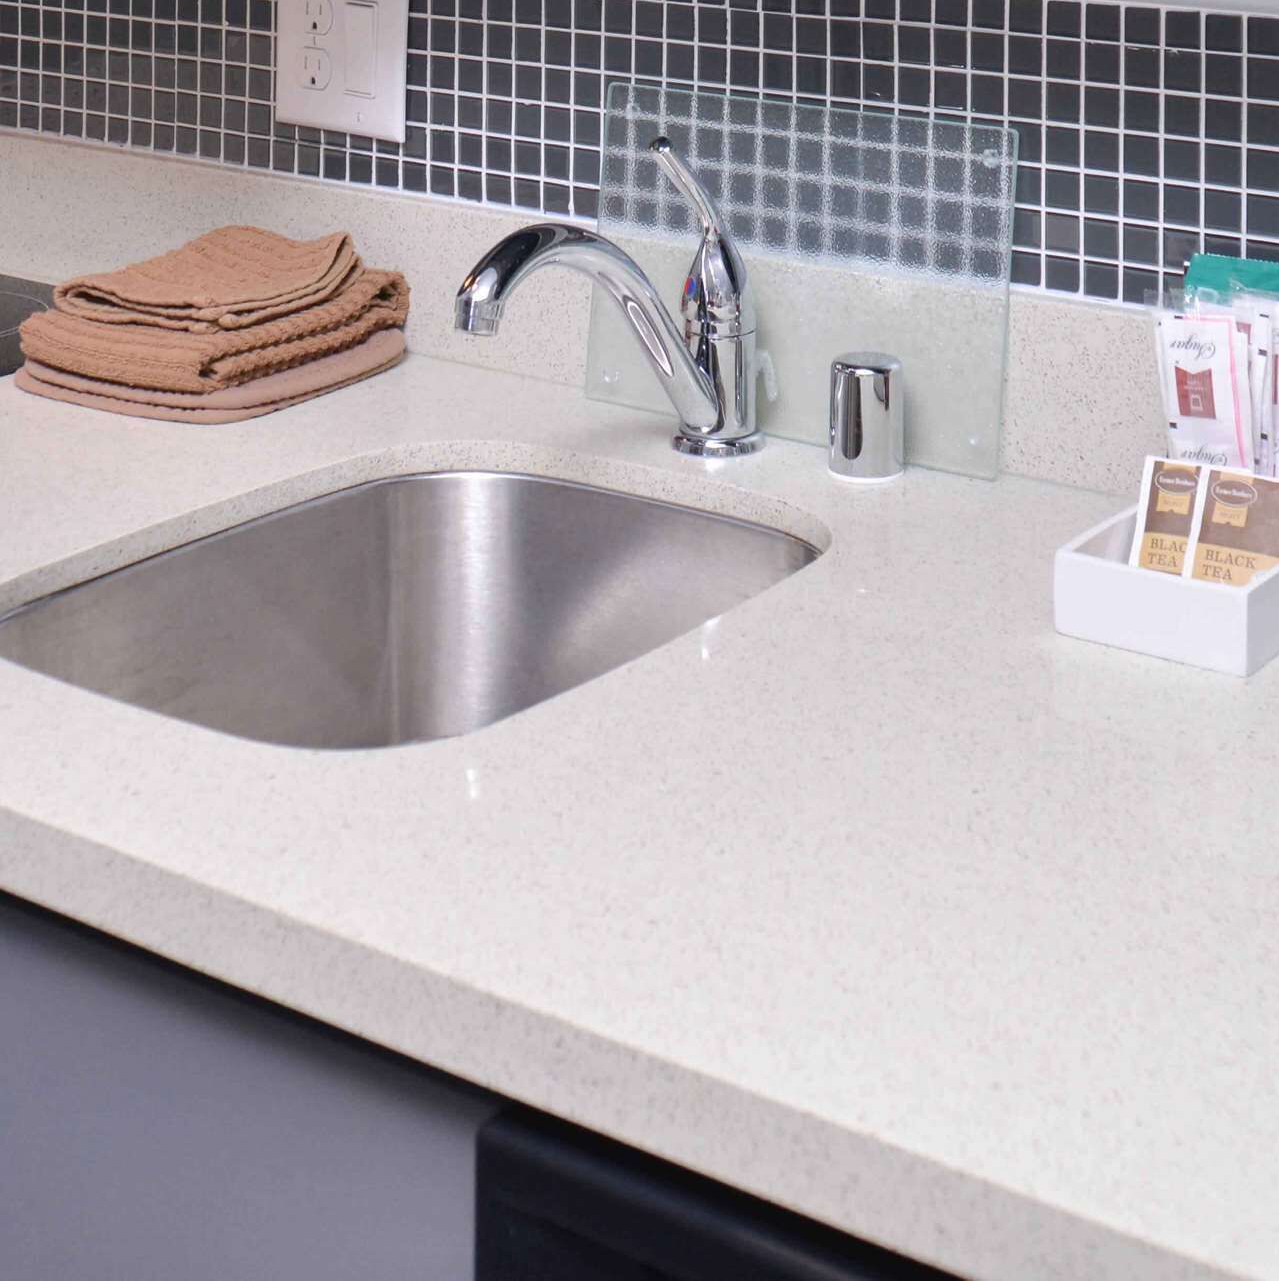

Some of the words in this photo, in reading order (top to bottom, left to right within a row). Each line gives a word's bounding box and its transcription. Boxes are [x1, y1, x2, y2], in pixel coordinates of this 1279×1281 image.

[1169, 334, 1216, 359] Sugar
[1180, 444, 1228, 467] Sugar
[1150, 537, 1188, 553] BLAC
[1147, 552, 1178, 568] TEA
[1205, 549, 1257, 570] BLACK
[1202, 564, 1233, 580] TEA
